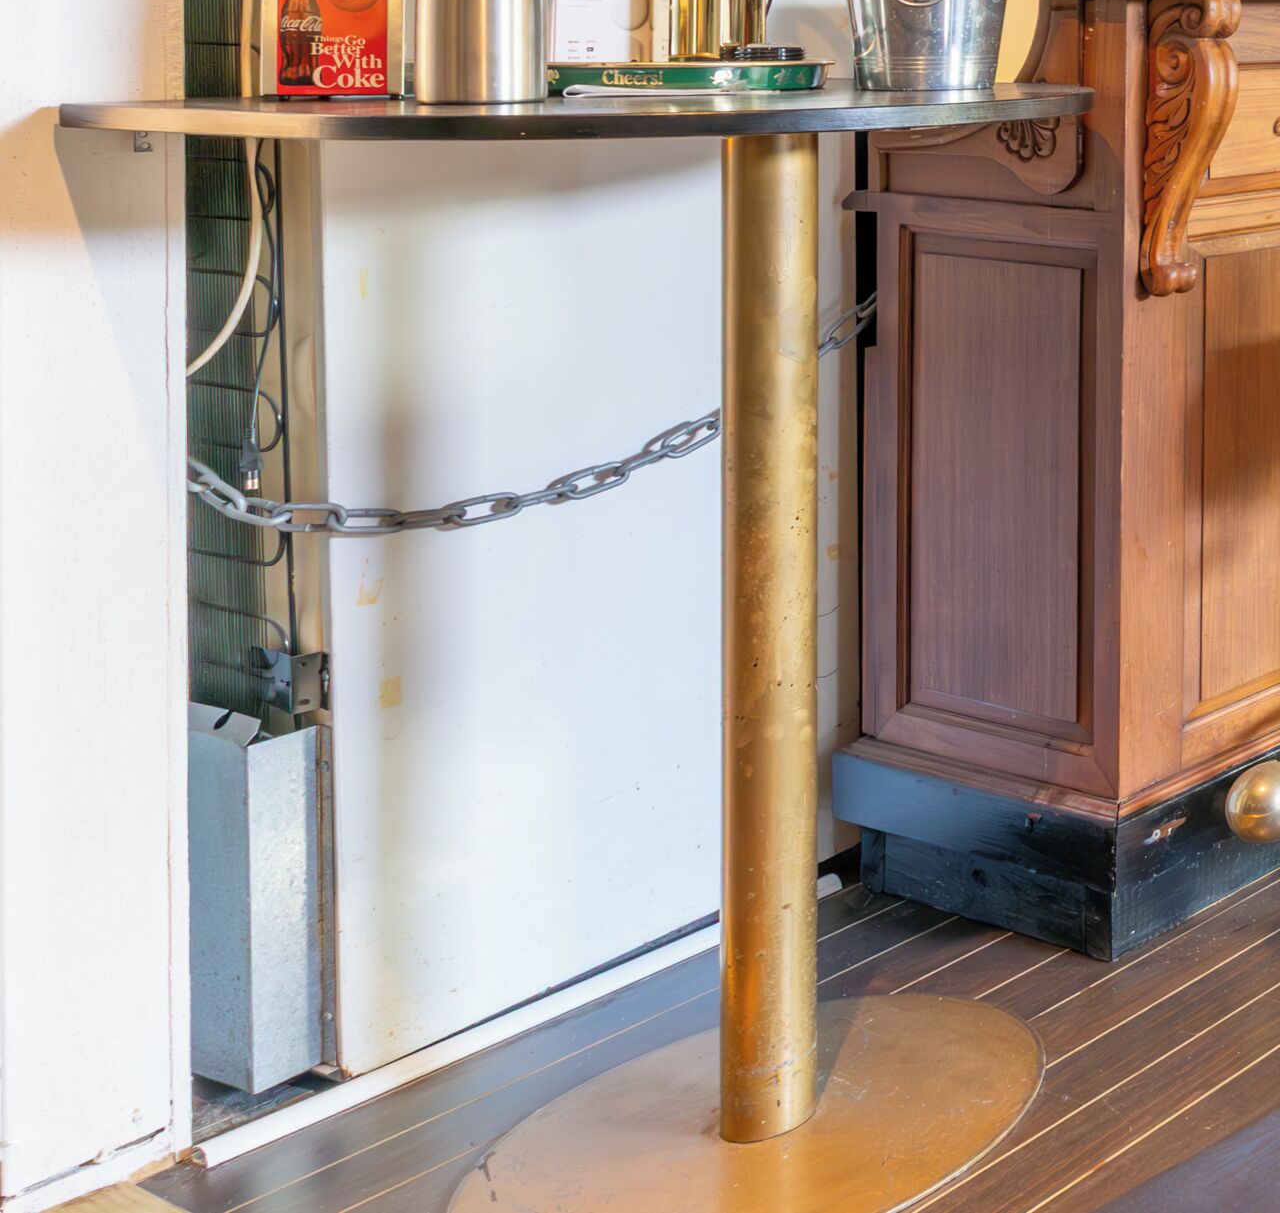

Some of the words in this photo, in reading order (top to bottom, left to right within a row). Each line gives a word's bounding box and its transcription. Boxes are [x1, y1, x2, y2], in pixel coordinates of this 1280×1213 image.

[314, 35, 344, 44] Things
[345, 35, 366, 46] Go
[310, 42, 365, 56] Better
[332, 54, 383, 69] With
[313, 65, 385, 88] Coke
[602, 70, 664, 86] Cheers!
